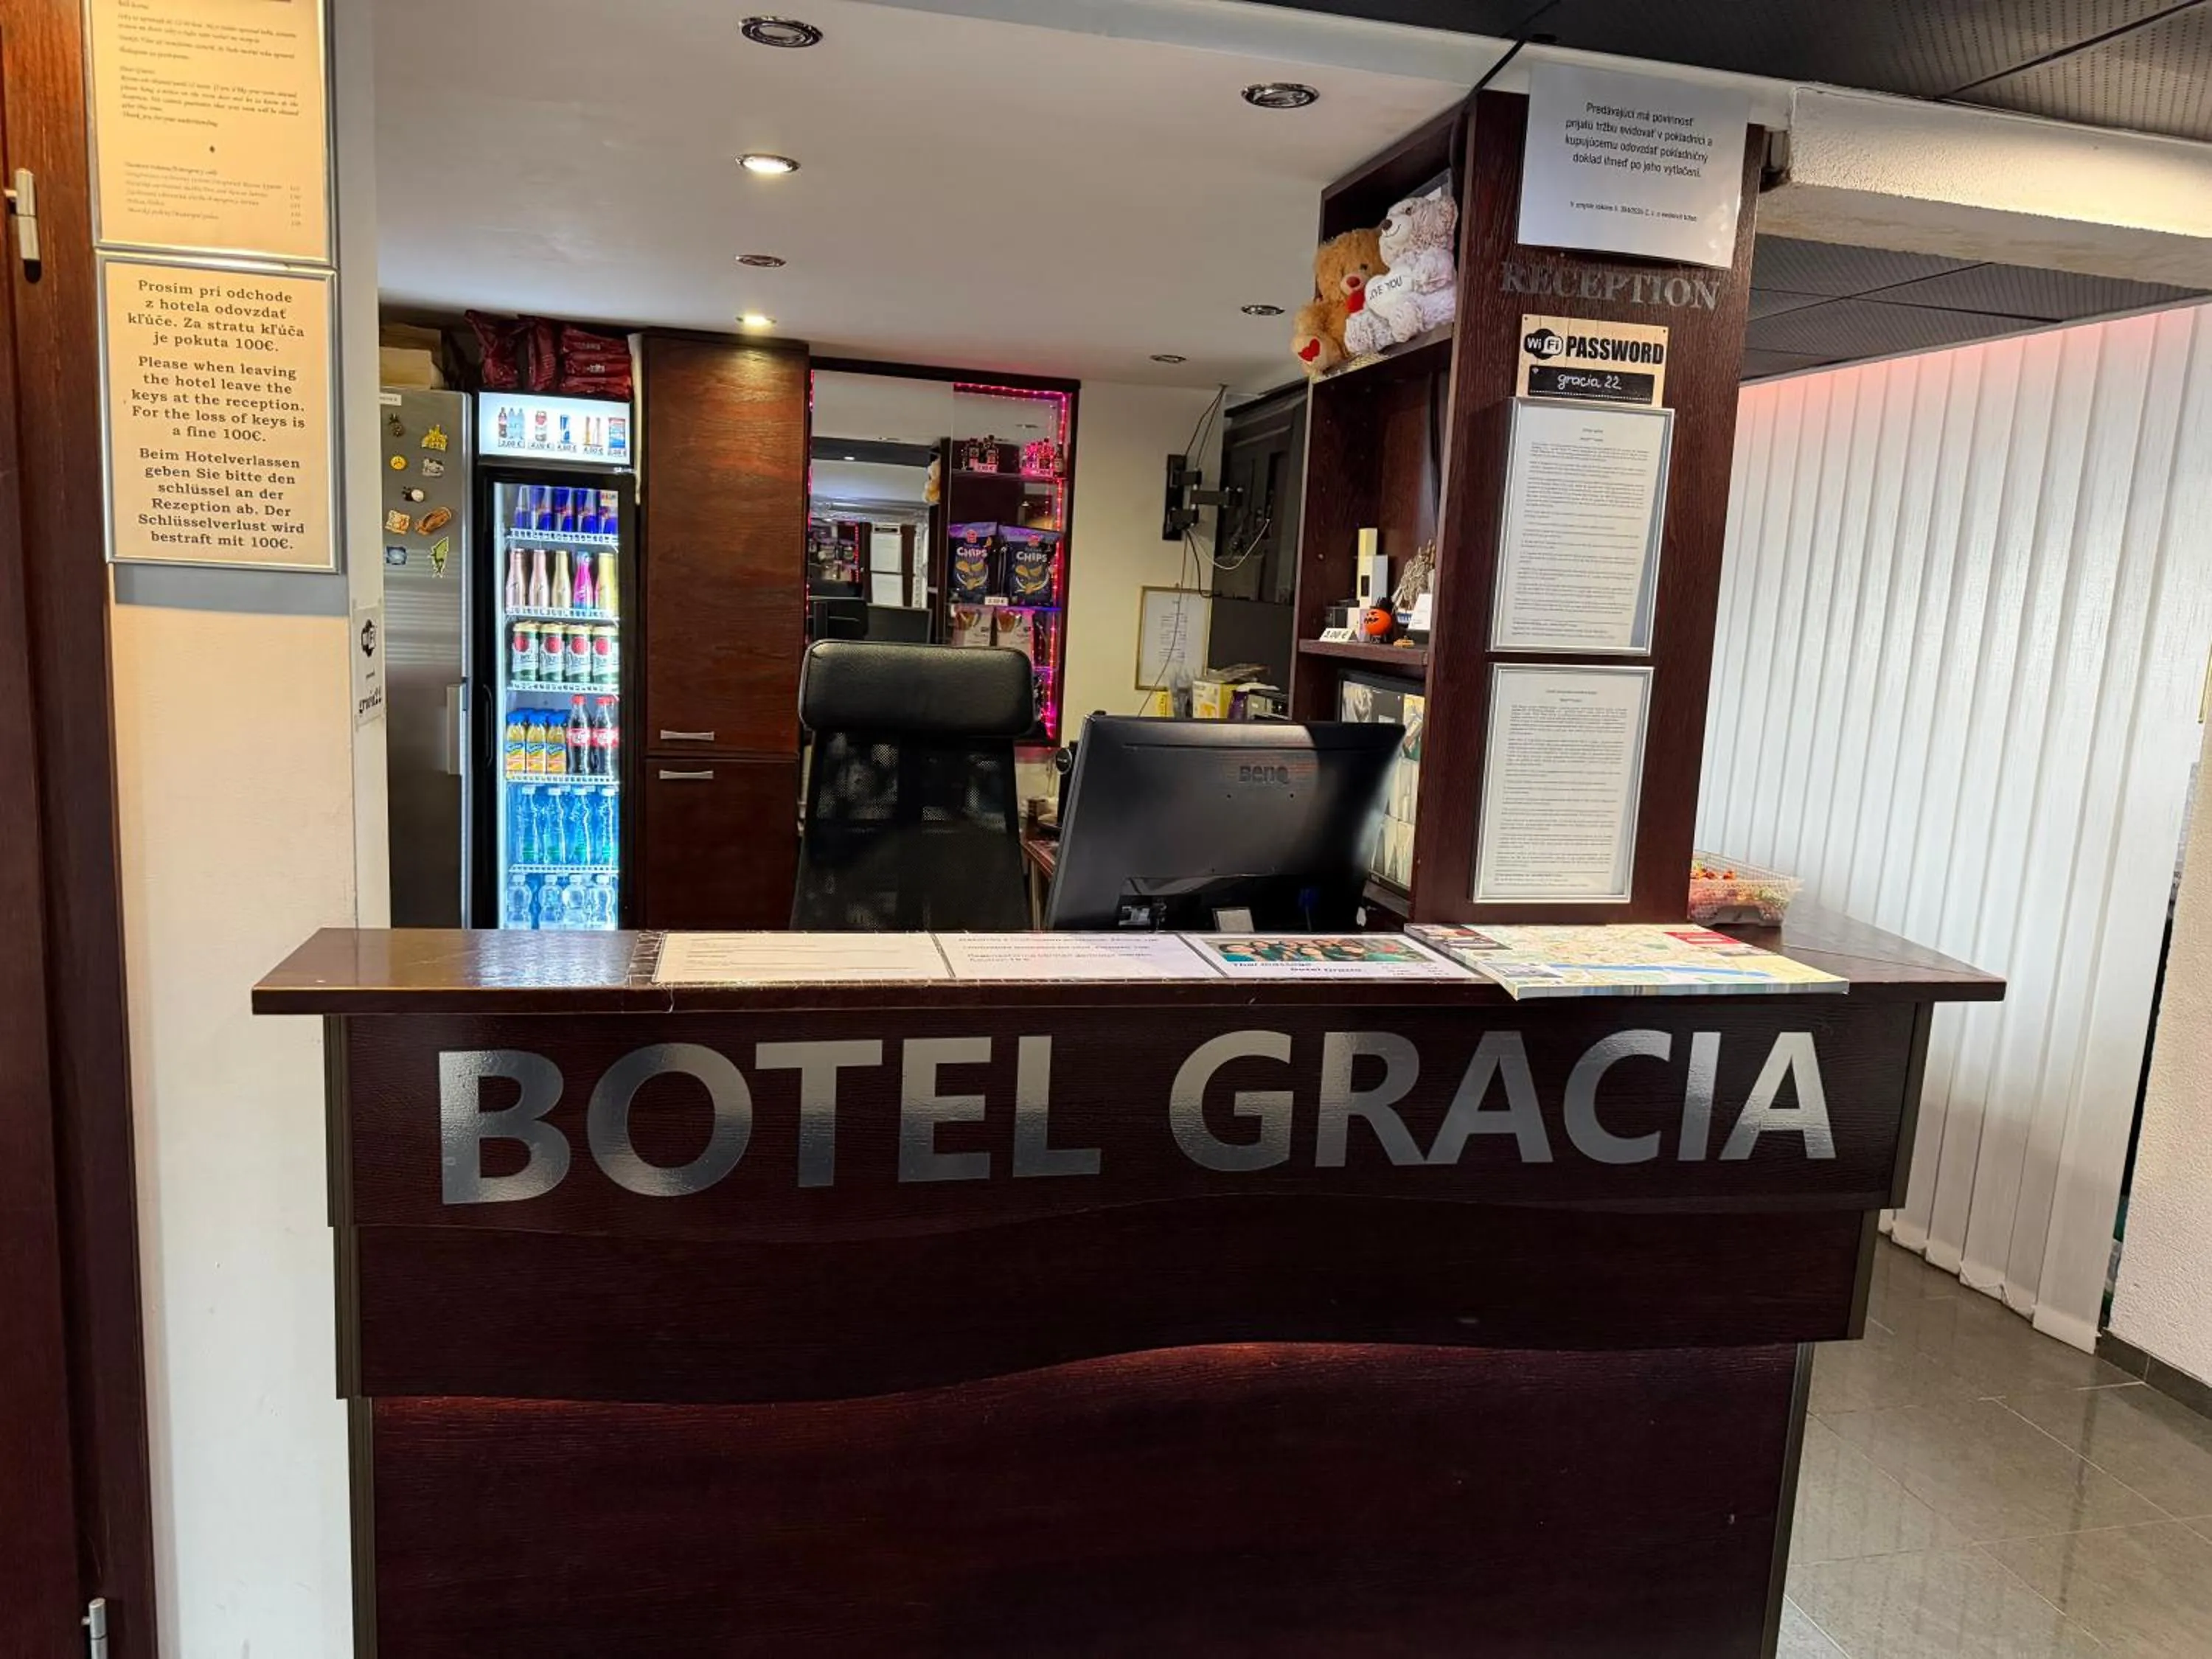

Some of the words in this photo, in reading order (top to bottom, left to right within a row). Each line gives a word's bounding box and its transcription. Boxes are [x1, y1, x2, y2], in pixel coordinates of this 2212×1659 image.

[1630, 161, 1641, 171] po
[200, 285, 221, 299] pri
[226, 288, 293, 303] odchode
[1500, 261, 1720, 310] RECEPTION
[145, 300, 154, 308] z
[159, 298, 209, 313] hotela
[184, 317, 201, 329] Za
[207, 321, 254, 333] stratu
[153, 331, 168, 346] je
[174, 334, 229, 348] pokuta
[236, 338, 279, 352] 100€.
[1566, 335, 1663, 364] PASSWORD
[139, 355, 188, 369] Please
[193, 361, 235, 374] when
[240, 363, 296, 381] leaving
[143, 373, 169, 386] the
[175, 375, 216, 389] hotel
[220, 378, 261, 392] leave
[266, 382, 292, 394] the
[1557, 373, 1601, 390] gracia
[1604, 375, 1621, 390] 22
[131, 389, 167, 404] keys
[173, 393, 189, 403] at
[194, 393, 220, 406] the
[226, 398, 305, 412] reception.
[132, 405, 159, 418] For
[164, 408, 190, 420] the
[195, 409, 226, 422] loss
[231, 413, 248, 424] of
[251, 414, 288, 429] keys
[293, 416, 305, 428] is
[172, 428, 181, 436] a
[187, 425, 216, 439] fine
[223, 428, 266, 442] 100€.
[139, 448, 180, 461] Beim
[185, 451, 300, 469] Hotelverlassen
[145, 465, 191, 479] geben
[196, 467, 220, 480] Sie
[225, 470, 262, 483] bitte
[268, 473, 296, 484] den
[158, 482, 230, 497] schlüssel
[235, 489, 254, 498] an
[259, 488, 284, 501] der
[151, 498, 231, 514] Rezeption
[236, 504, 259, 515] ab.
[264, 504, 291, 517] Der
[138, 513, 267, 532] Schlüsselverlust
[271, 522, 305, 534] wird
[150, 530, 212, 545] bestraft
[218, 535, 245, 546] mit
[251, 537, 294, 549] 100€.
[1239, 765, 1289, 785] BenQ
[439, 1034, 1102, 1204] BOTEL
[1169, 1029, 1837, 1172] GRACIA
